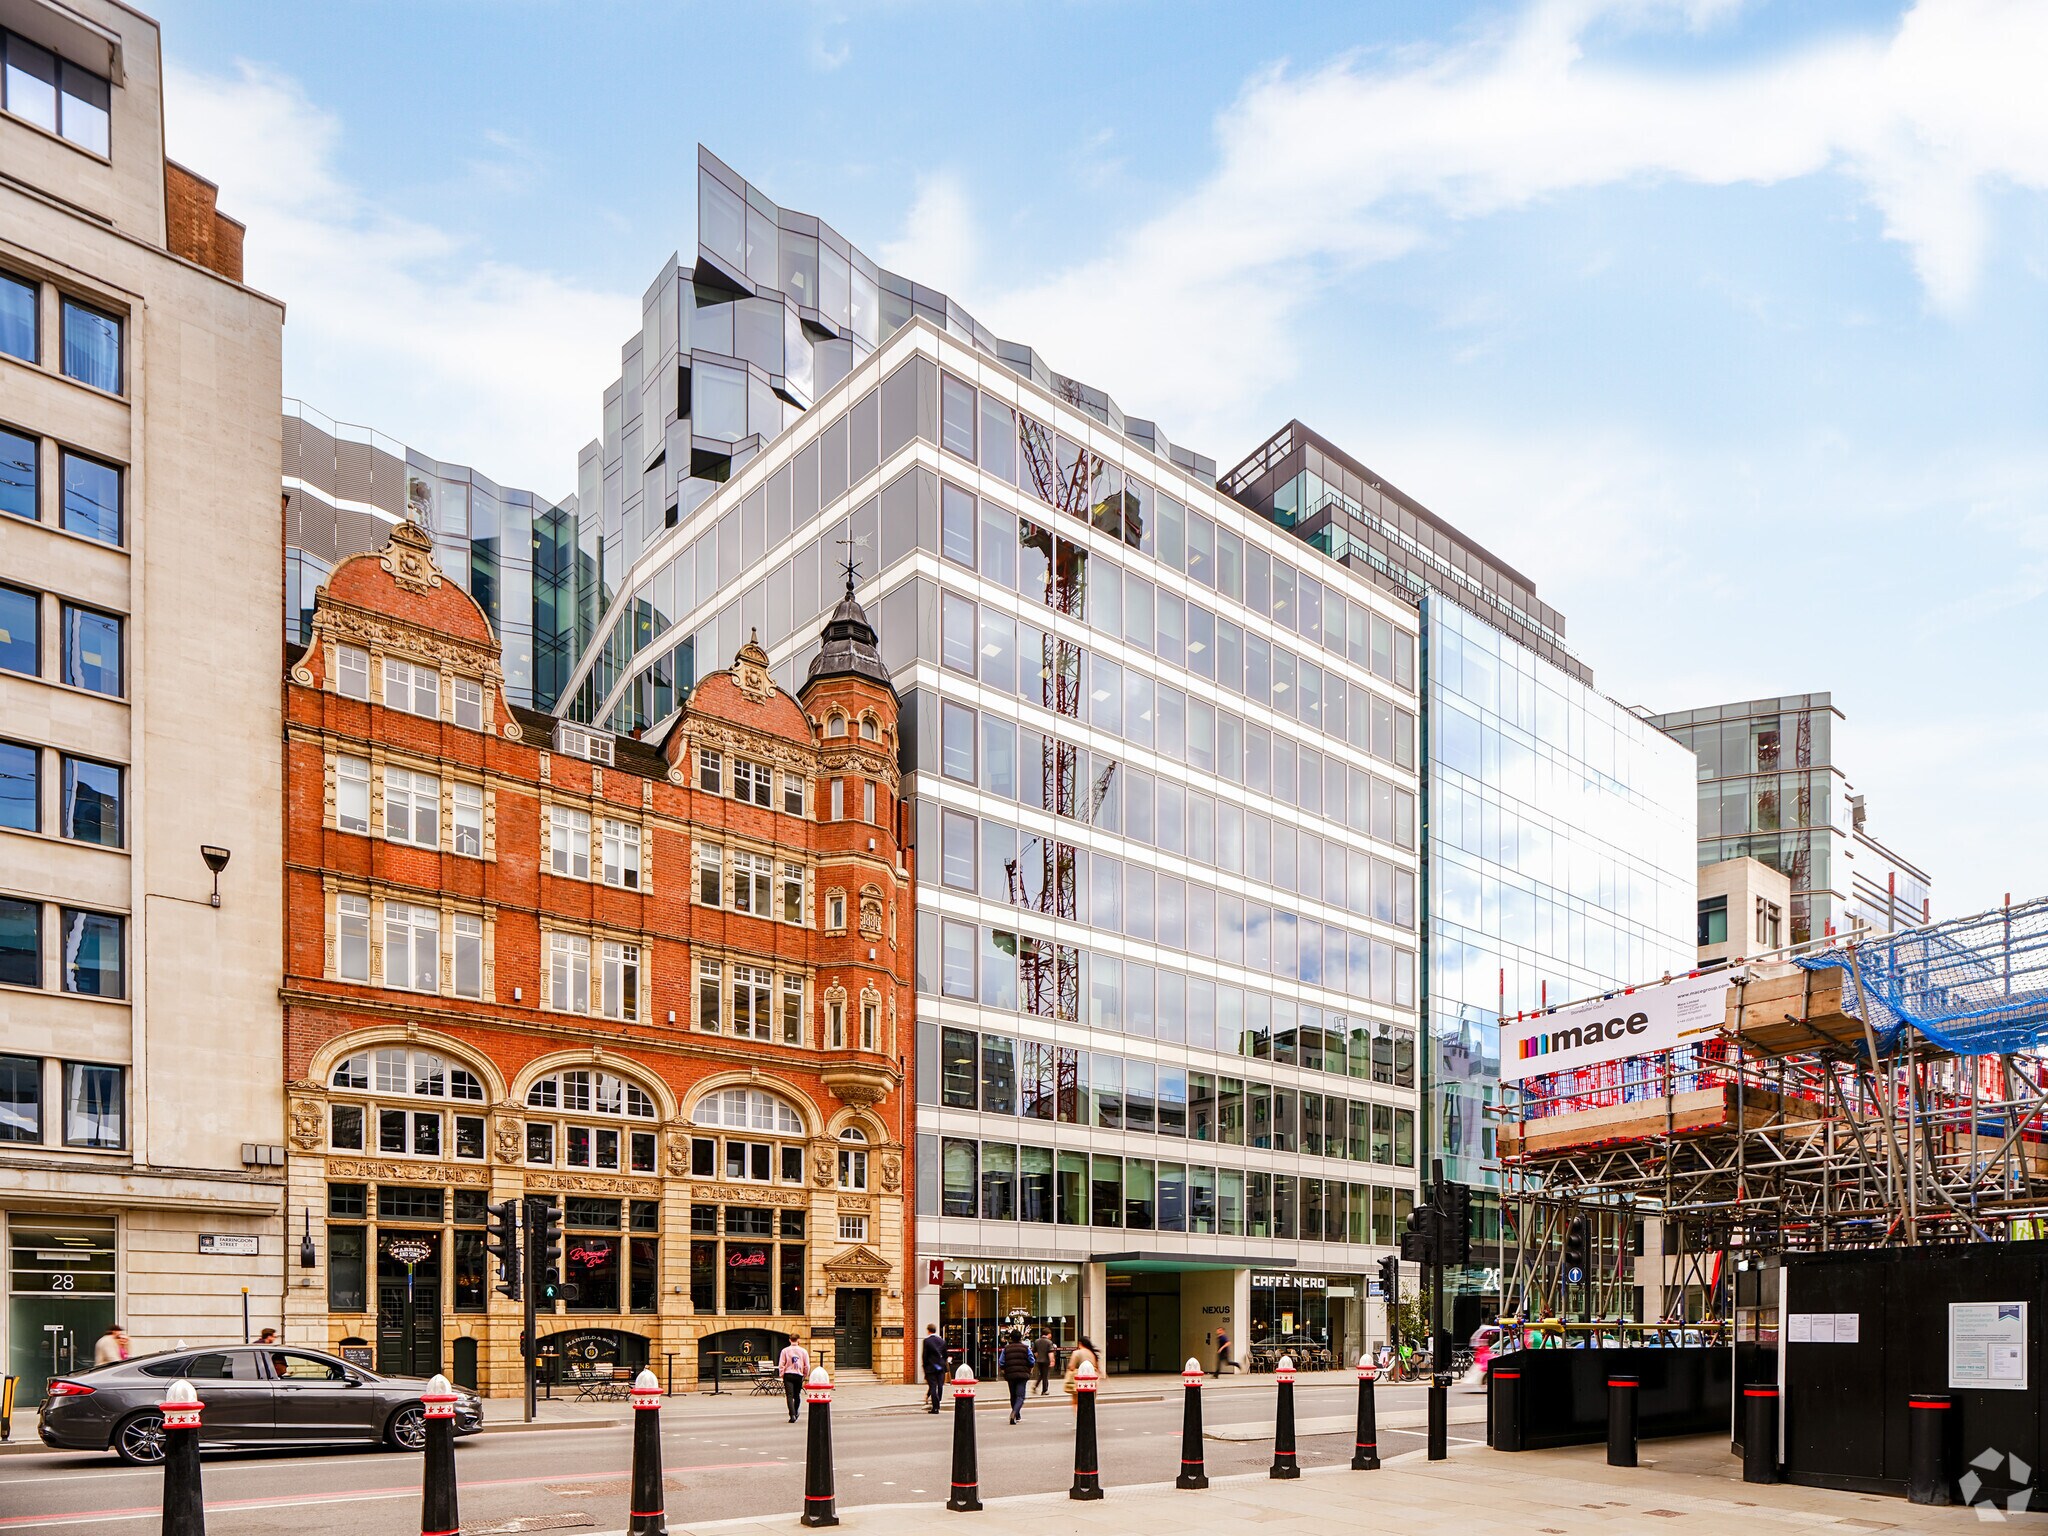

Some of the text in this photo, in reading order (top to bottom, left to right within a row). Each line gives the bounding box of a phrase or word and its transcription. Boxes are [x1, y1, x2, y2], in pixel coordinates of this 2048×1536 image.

[1551, 1012, 1649, 1053] mace
[584, 1255, 605, 1268] Bar
[52, 1274, 74, 1290] 28
[970, 1263, 1053, 1286] PRET A MANGER
[1252, 1273, 1326, 1289] CAFFÈ NERO
[1202, 1305, 1231, 1314] NEXUS
[565, 1335, 597, 1348] HARRILD
